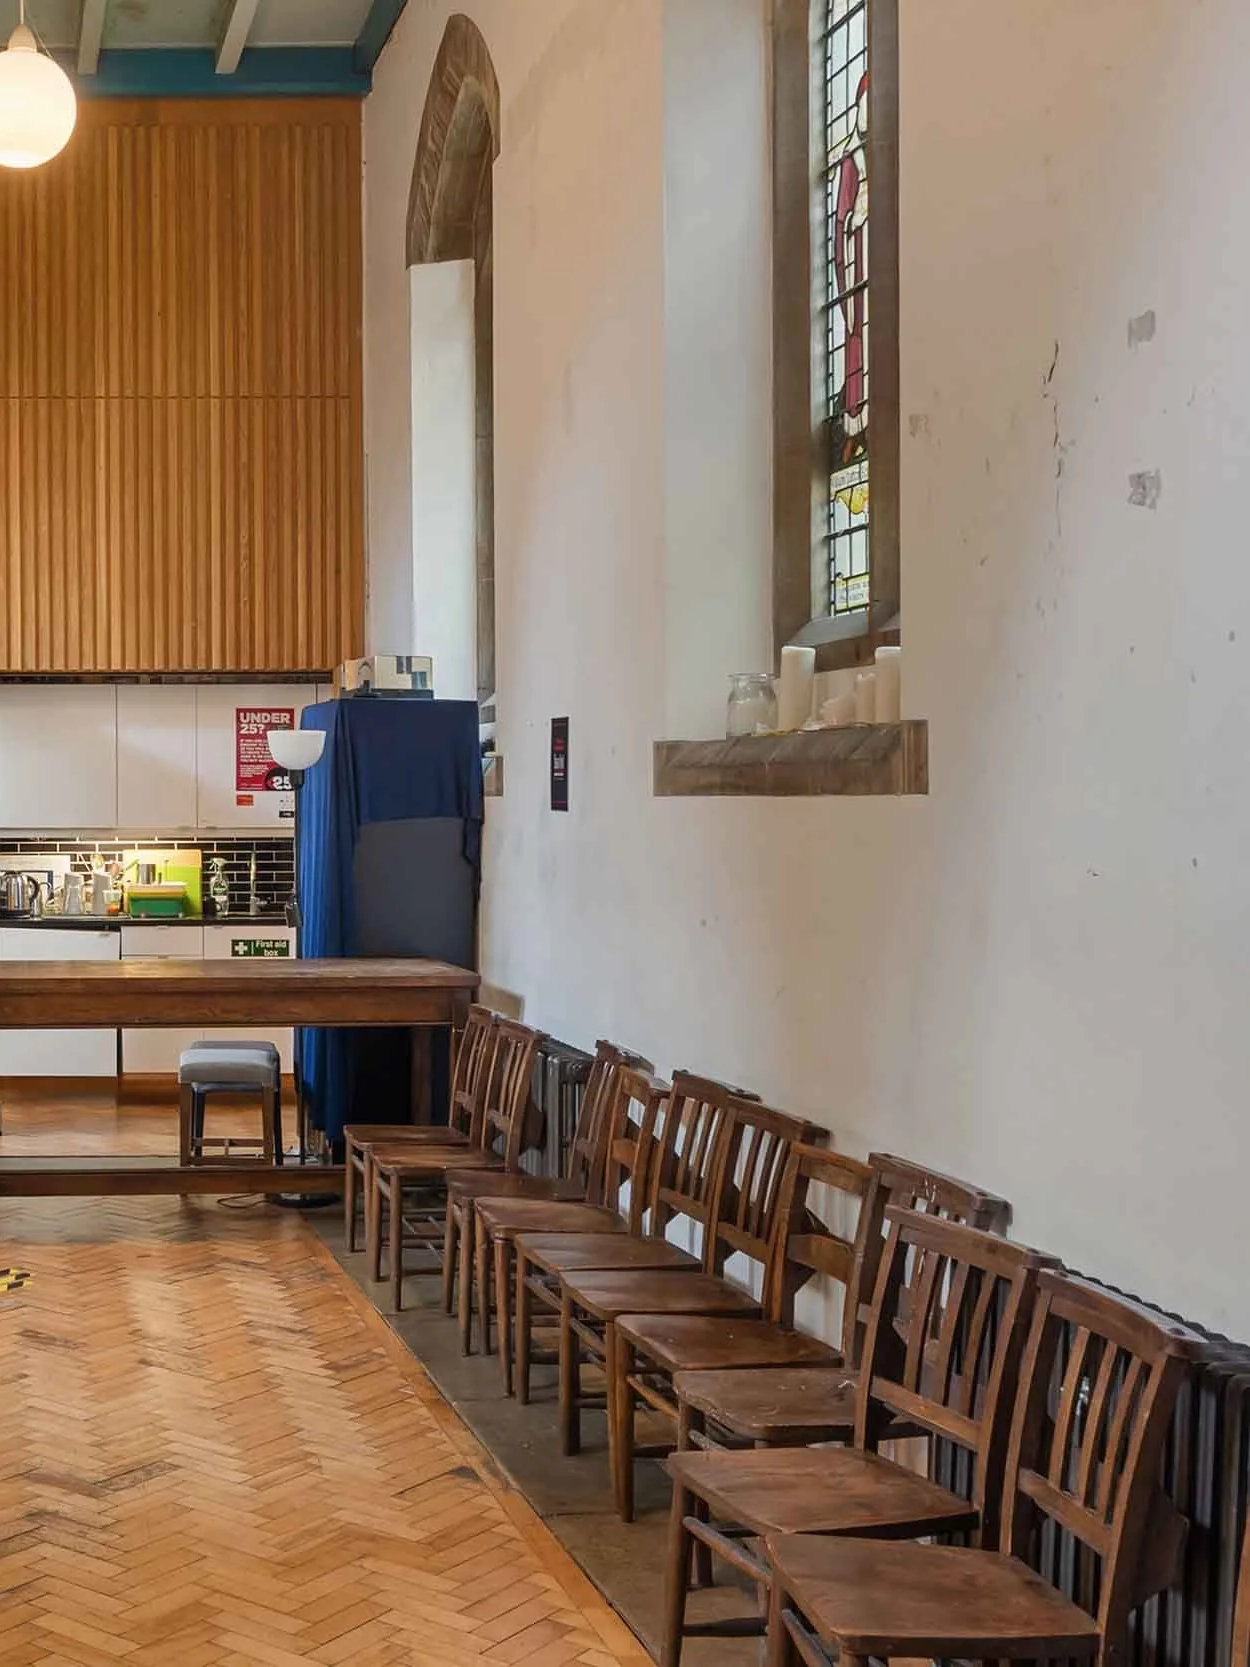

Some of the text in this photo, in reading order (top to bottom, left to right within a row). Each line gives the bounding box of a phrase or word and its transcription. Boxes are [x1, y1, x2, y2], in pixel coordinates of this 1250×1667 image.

[239, 712, 291, 724] UNDER
[239, 723, 265, 735] 25?
[272, 776, 292, 790] 25
[255, 940, 287, 948] First aid
[263, 949, 279, 957] box
